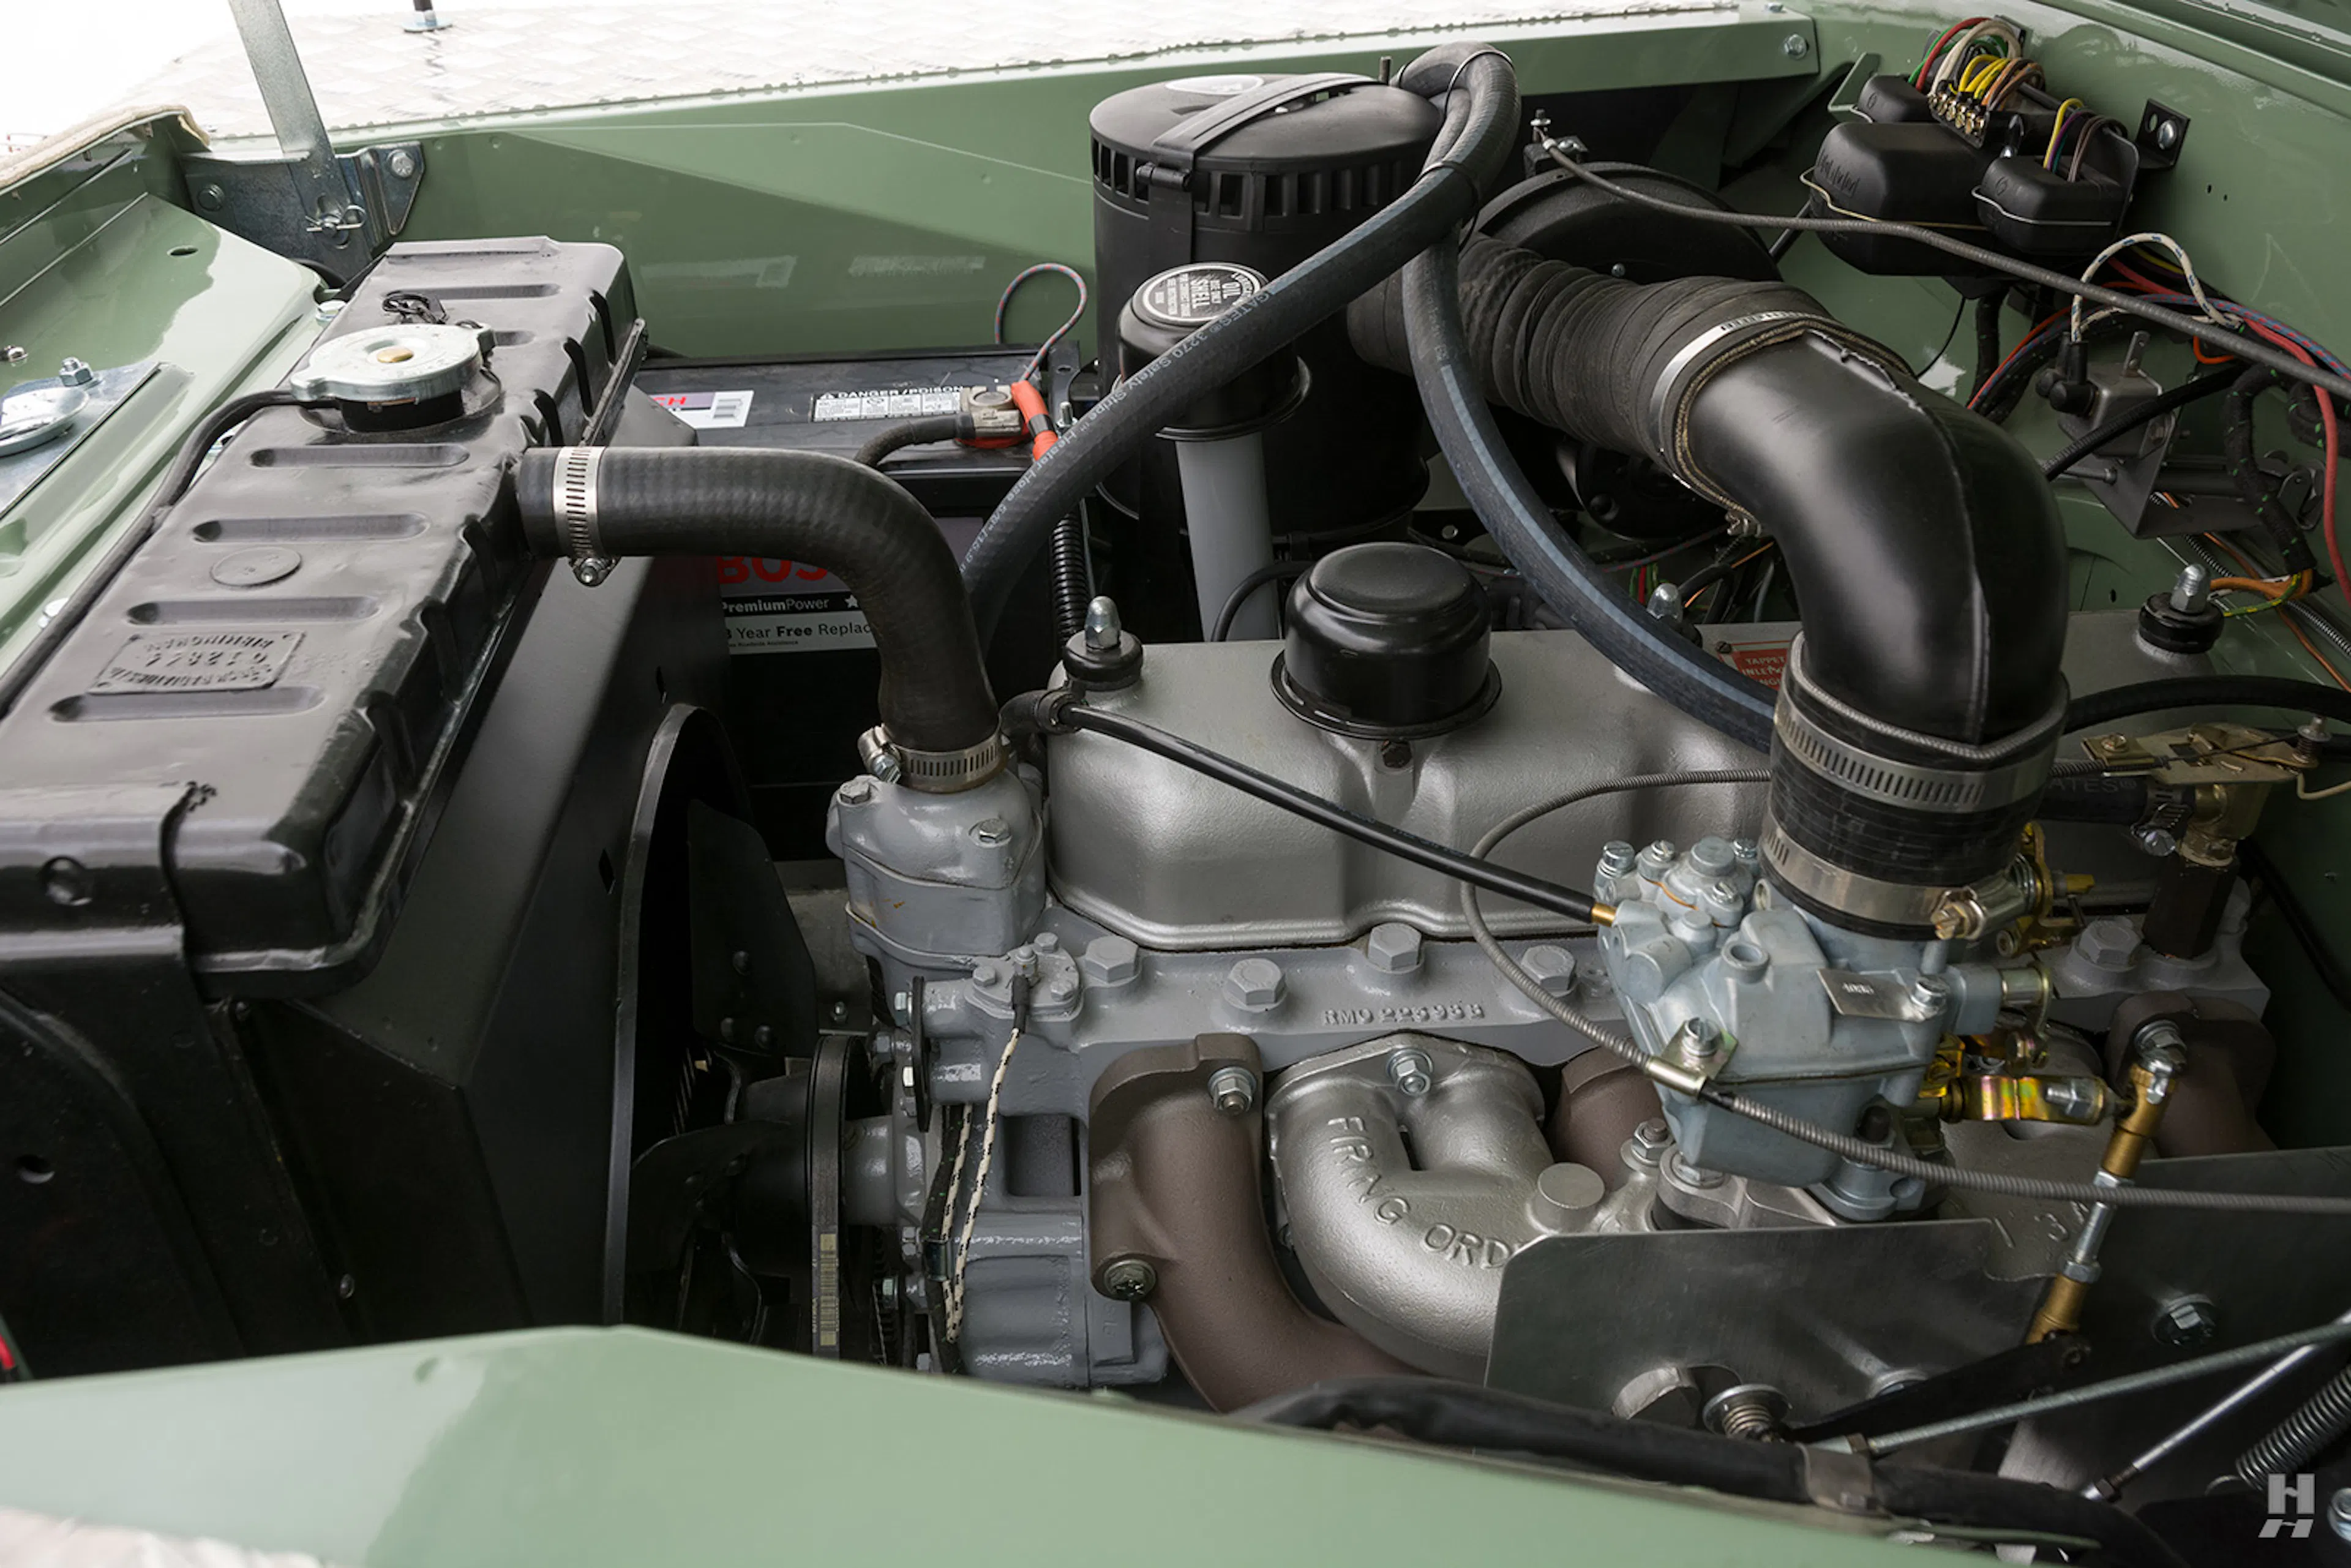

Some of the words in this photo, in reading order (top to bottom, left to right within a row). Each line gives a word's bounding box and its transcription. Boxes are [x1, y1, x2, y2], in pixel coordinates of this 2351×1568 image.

[1190, 279, 1210, 309] SHELL
[1222, 281, 1240, 299] OIL
[1172, 329, 1208, 359] 3270
[1128, 358, 1172, 390] Safety
[1037, 430, 1078, 472] Heater
[1007, 468, 1038, 502] Hose
[736, 627, 771, 640] Year
[776, 626, 813, 637] Free
[818, 621, 872, 636] Replac
[1327, 1116, 1411, 1225] FIRING
[1421, 1222, 1512, 1270] ORD
